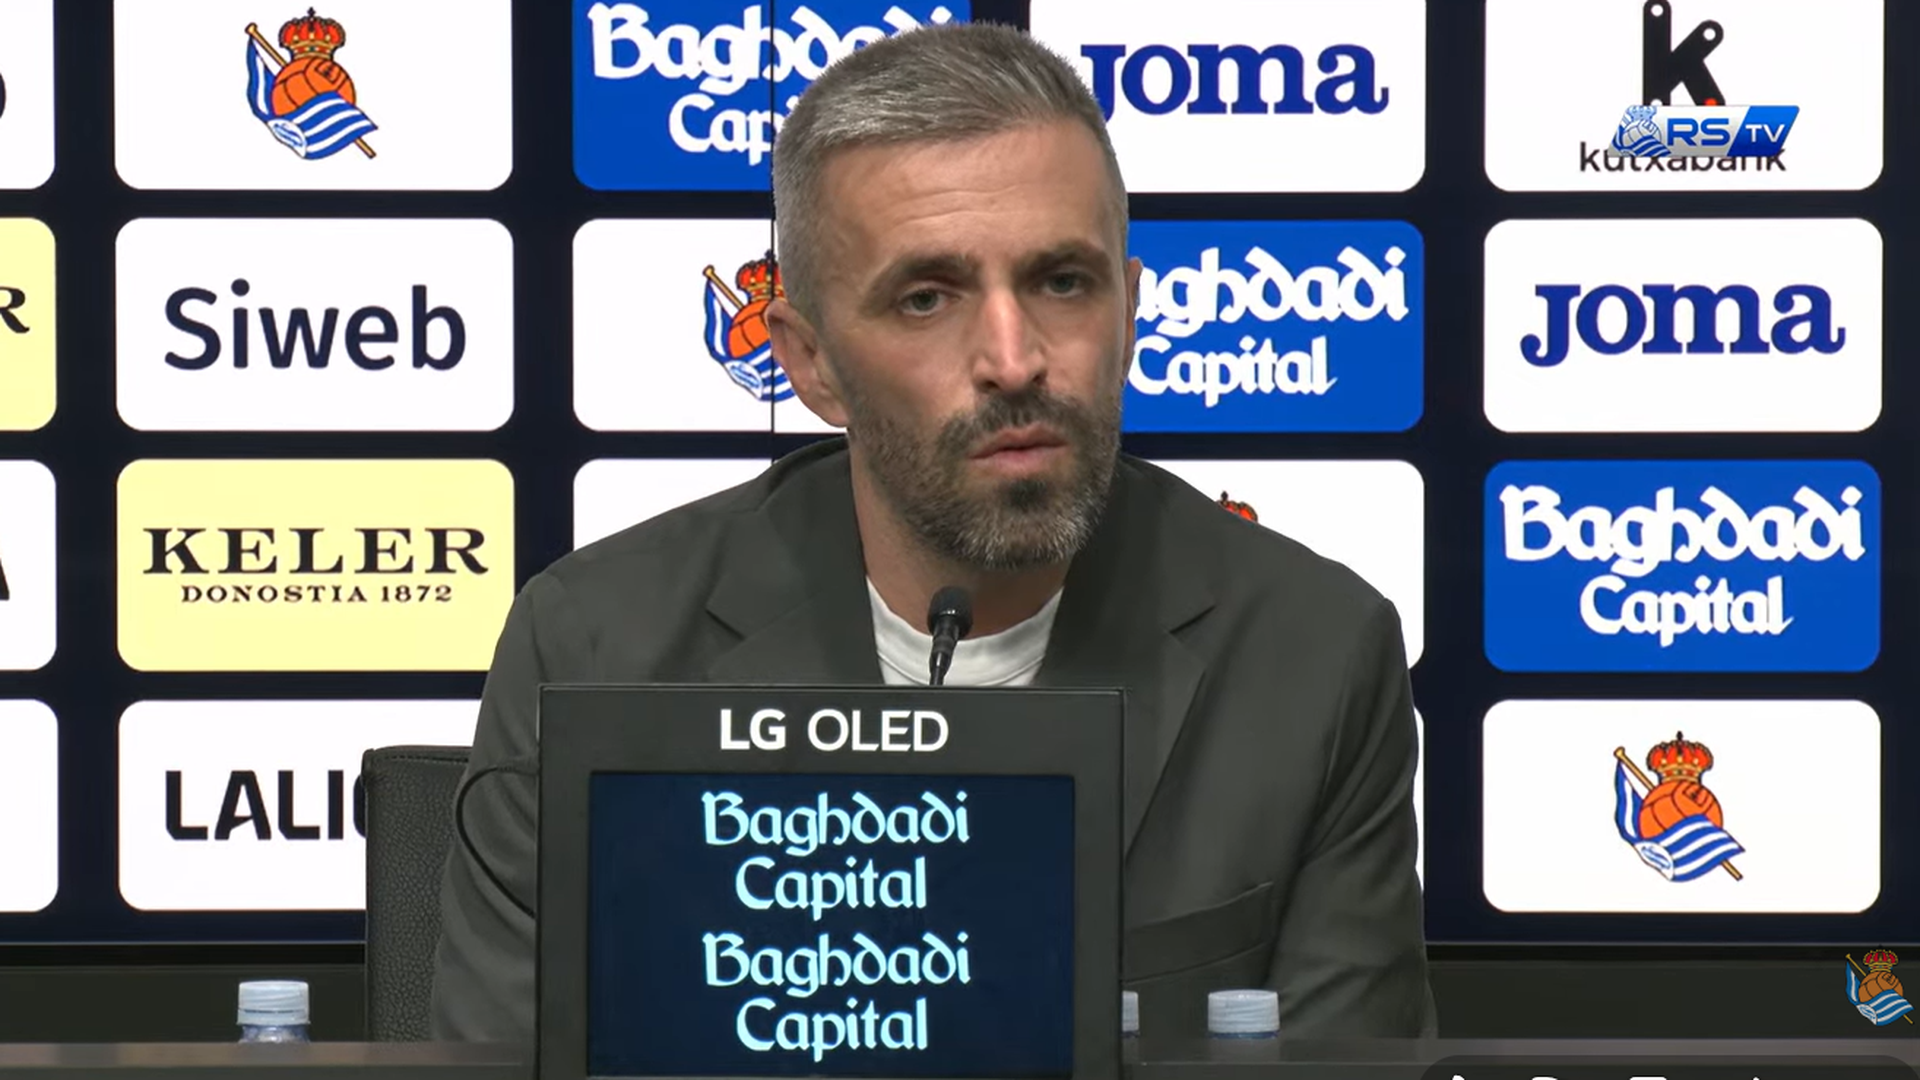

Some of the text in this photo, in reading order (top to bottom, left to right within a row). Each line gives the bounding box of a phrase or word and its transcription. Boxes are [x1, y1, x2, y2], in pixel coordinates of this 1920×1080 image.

[587, 2, 951, 95] Baghd
[165, 279, 466, 371] Siweb
[1520, 284, 1846, 367] Joma
[1128, 335, 1337, 408] Capital
[142, 527, 489, 575] KELER
[1500, 485, 1866, 577] Baghdadi
[181, 585, 453, 603] DONOSTIA 1872
[1580, 575, 1794, 647] Capital
[720, 709, 949, 752] LG OLED
[165, 770, 365, 840] LALI
[701, 790, 970, 857] Baghdadi
[735, 856, 927, 921] Capital
[702, 931, 971, 998] Baghdadi
[736, 997, 928, 1063] Capital
